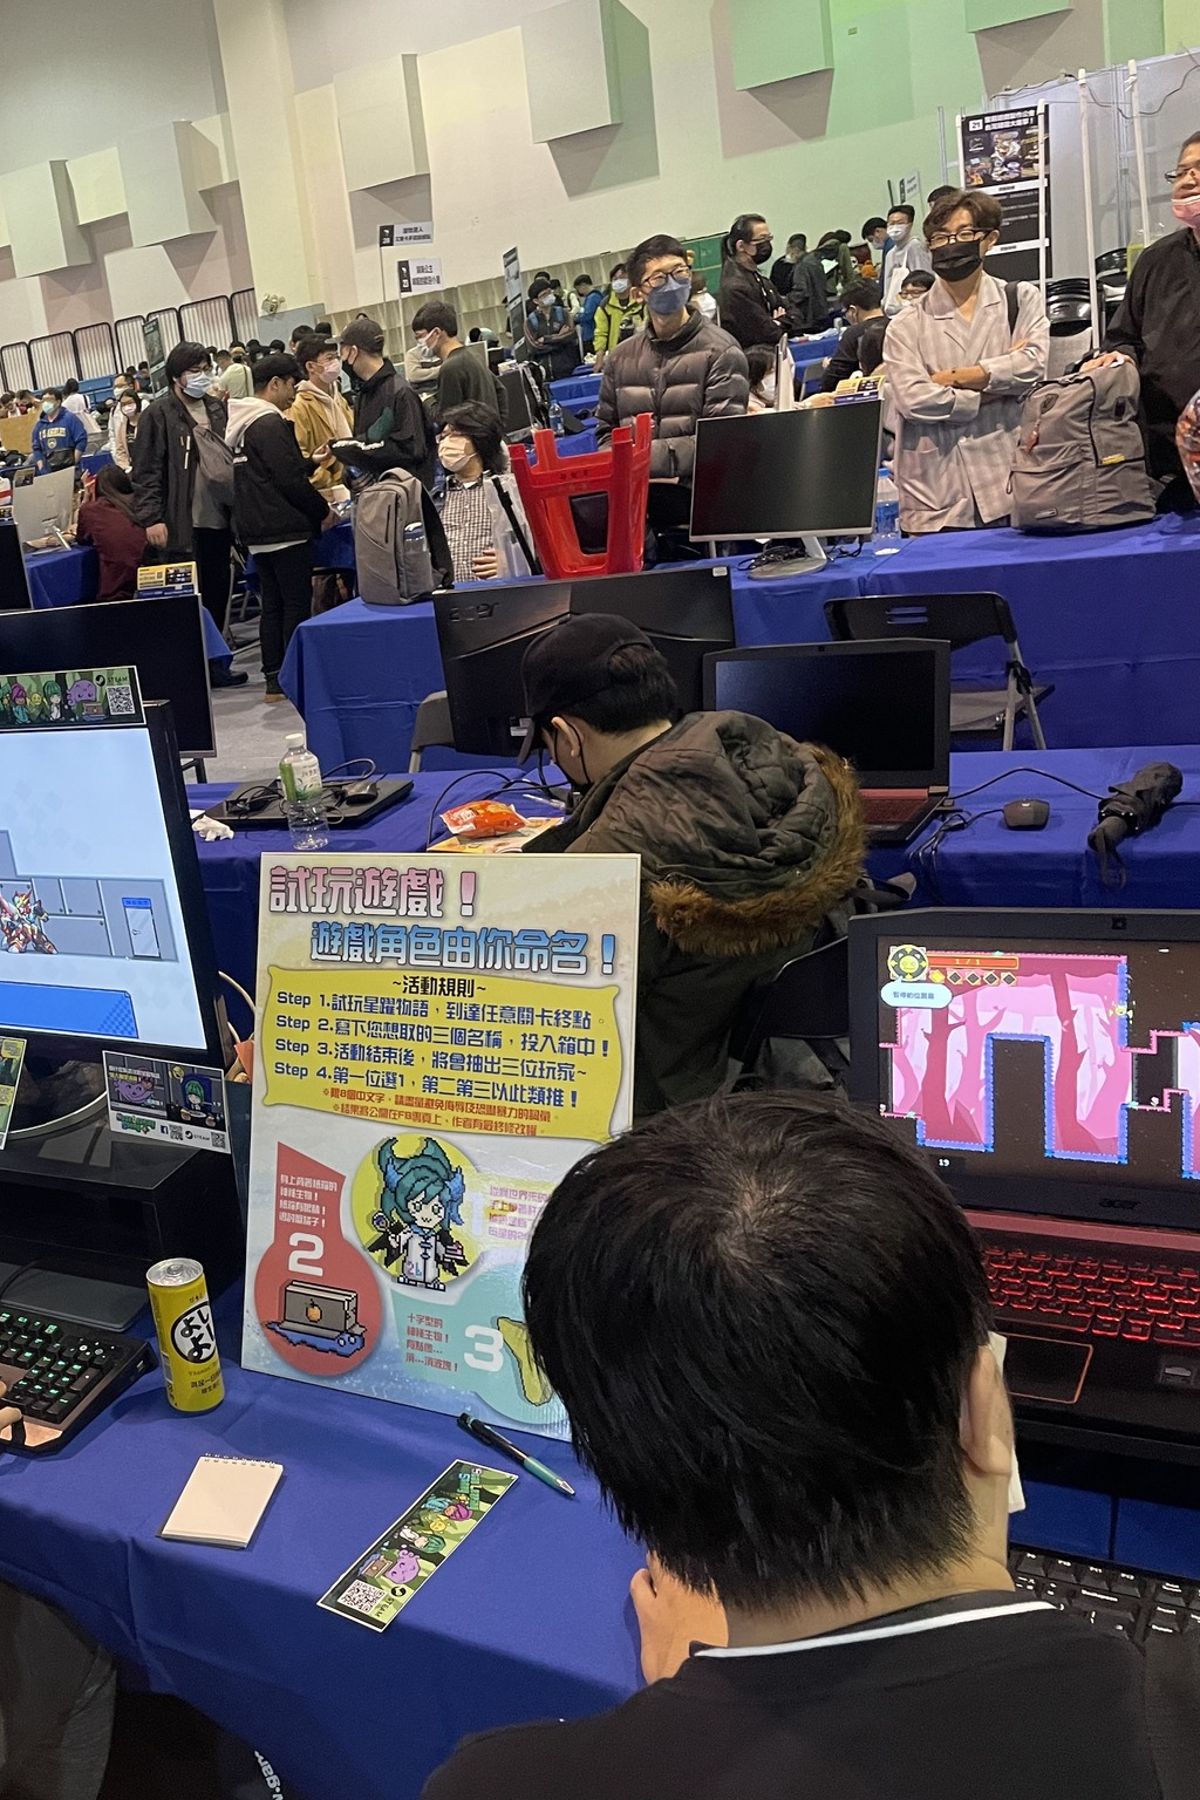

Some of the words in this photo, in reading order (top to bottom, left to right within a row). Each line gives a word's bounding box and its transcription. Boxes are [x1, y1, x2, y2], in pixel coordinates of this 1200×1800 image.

[269, 866, 476, 918] 試玩遊戲！
[311, 920, 616, 976] 遊戲角色由你命名！
[277, 991, 311, 1008] Step
[276, 1015, 310, 1032] Step
[275, 1038, 309, 1056] Step
[274, 1062, 308, 1079] Step
[938, 1158, 950, 1167] 19
[288, 1232, 324, 1277] 2
[464, 1325, 504, 1372] 3
